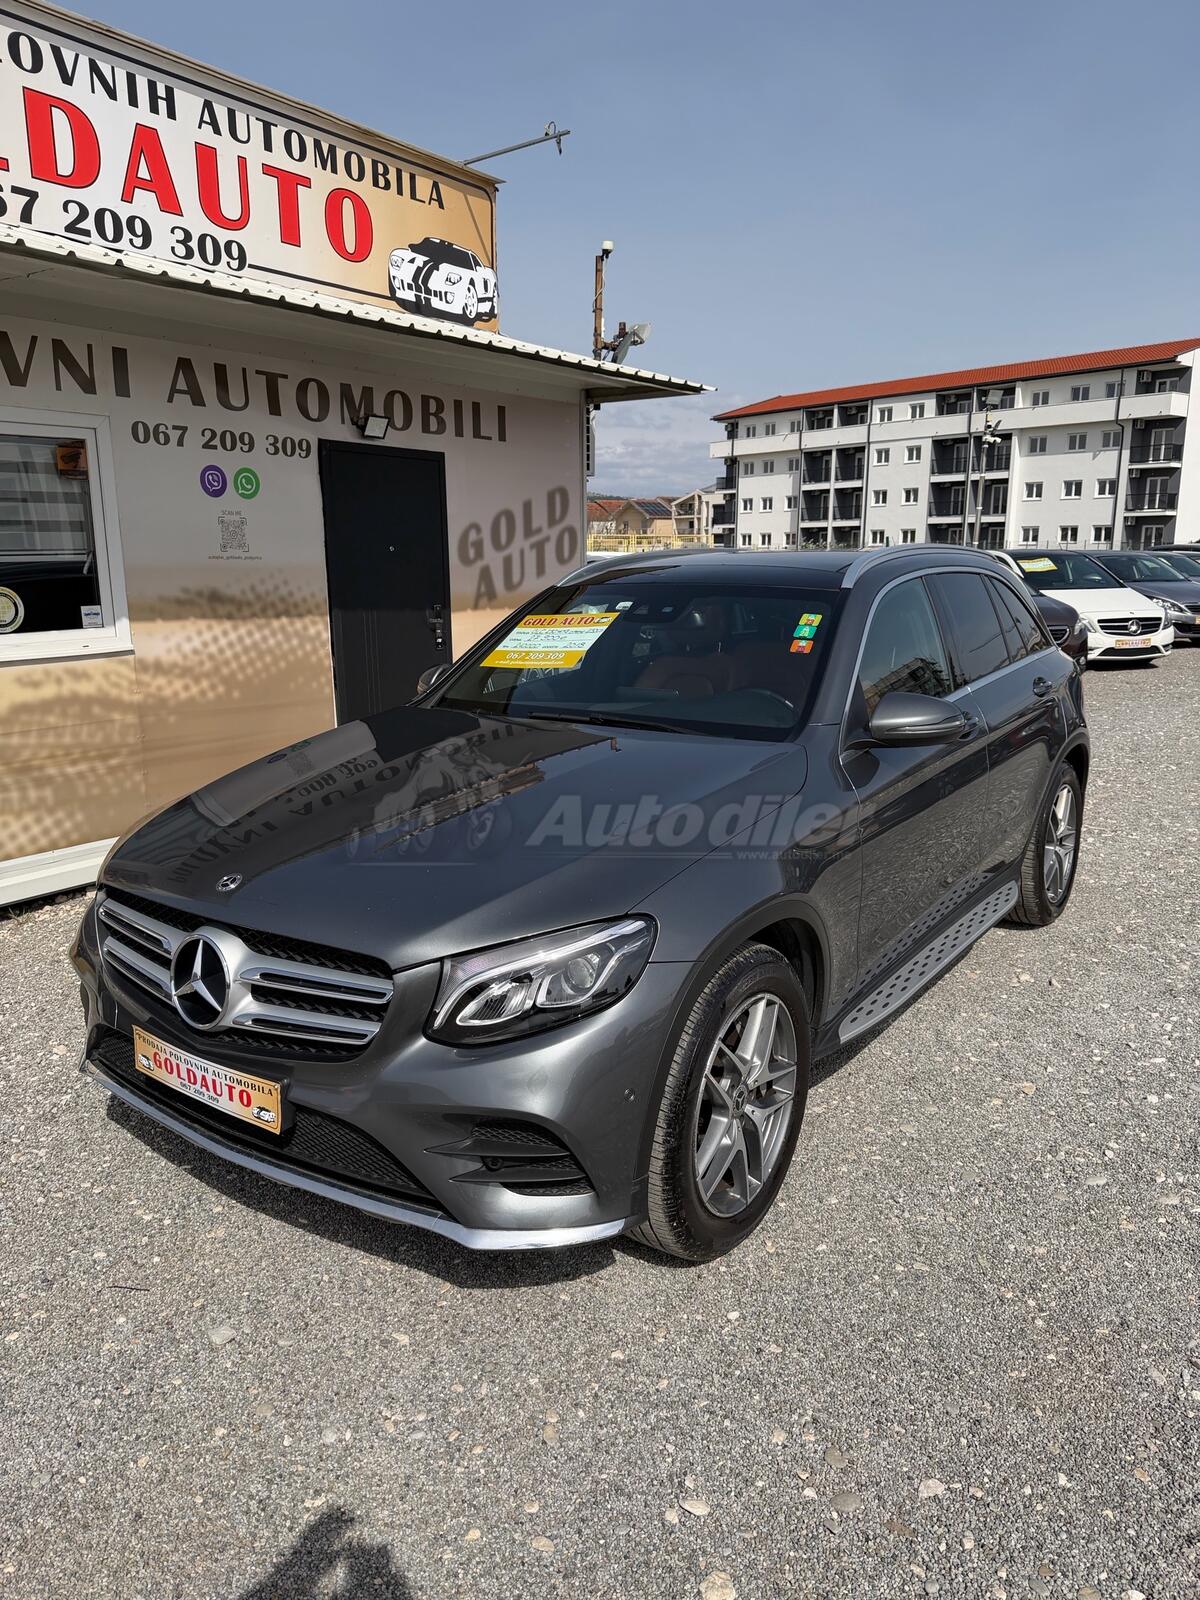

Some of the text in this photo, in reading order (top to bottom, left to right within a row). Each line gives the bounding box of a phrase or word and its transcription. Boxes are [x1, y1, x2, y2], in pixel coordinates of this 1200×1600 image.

[0, 31, 446, 210] OVNIH AUTOMOBILA
[0, 86, 373, 263] DAUTO
[62, 199, 152, 250] 209
[170, 226, 248, 272] 309
[0, 331, 507, 442] VNI AUTOMOBILI
[131, 420, 312, 459] 067 209 309
[457, 485, 570, 567] GOLD
[474, 525, 578, 609] AUTO
[523, 616, 595, 626] GOLD AUTO
[526, 652, 545, 660] 209
[138, 1032, 273, 1096] PRODAJA POLOVNIH AUTOMOBILA
[152, 1051, 252, 1108] GOLDAUTO
